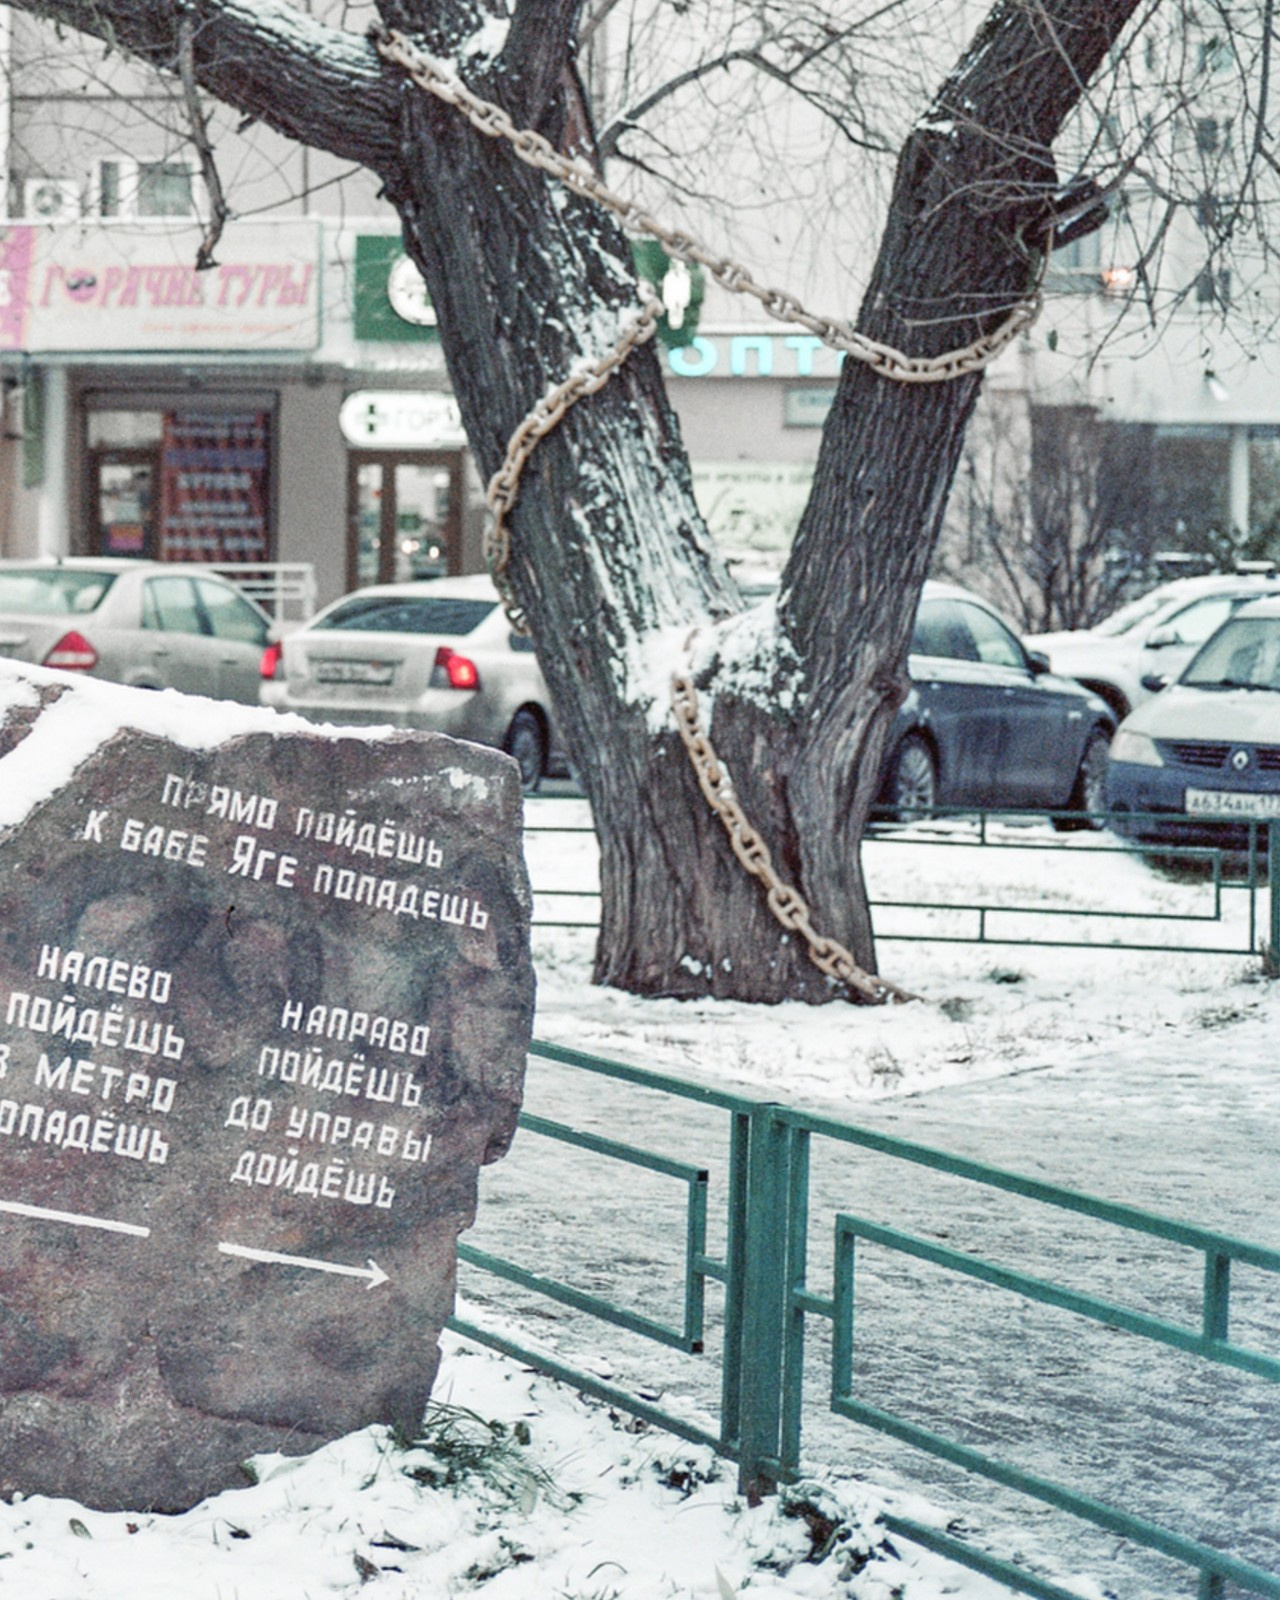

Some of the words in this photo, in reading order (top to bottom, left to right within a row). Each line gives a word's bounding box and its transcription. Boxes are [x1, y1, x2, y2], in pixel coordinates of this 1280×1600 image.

[218, 262, 314, 306] ТУРЫ
[668, 335, 847, 378] ОПТ
[83, 810, 109, 843] К
[120, 818, 210, 868] БАБЕ
[161, 773, 277, 831] ПРЯМО
[295, 808, 444, 869] ПОЙДЁШЬ
[37, 944, 172, 1004] НАЛЕВО
[6, 992, 185, 1060] ПОЙДЁШЬ
[281, 1000, 430, 1057] НАПРАВО
[34, 1053, 177, 1112] МЕТРО
[258, 1046, 421, 1108] ПОЙДЁШЬ
[224, 1096, 272, 1131] ДО
[285, 1106, 432, 1162] УПРАВЫ
[230, 1148, 395, 1209] ДОЙДЁШЬ
